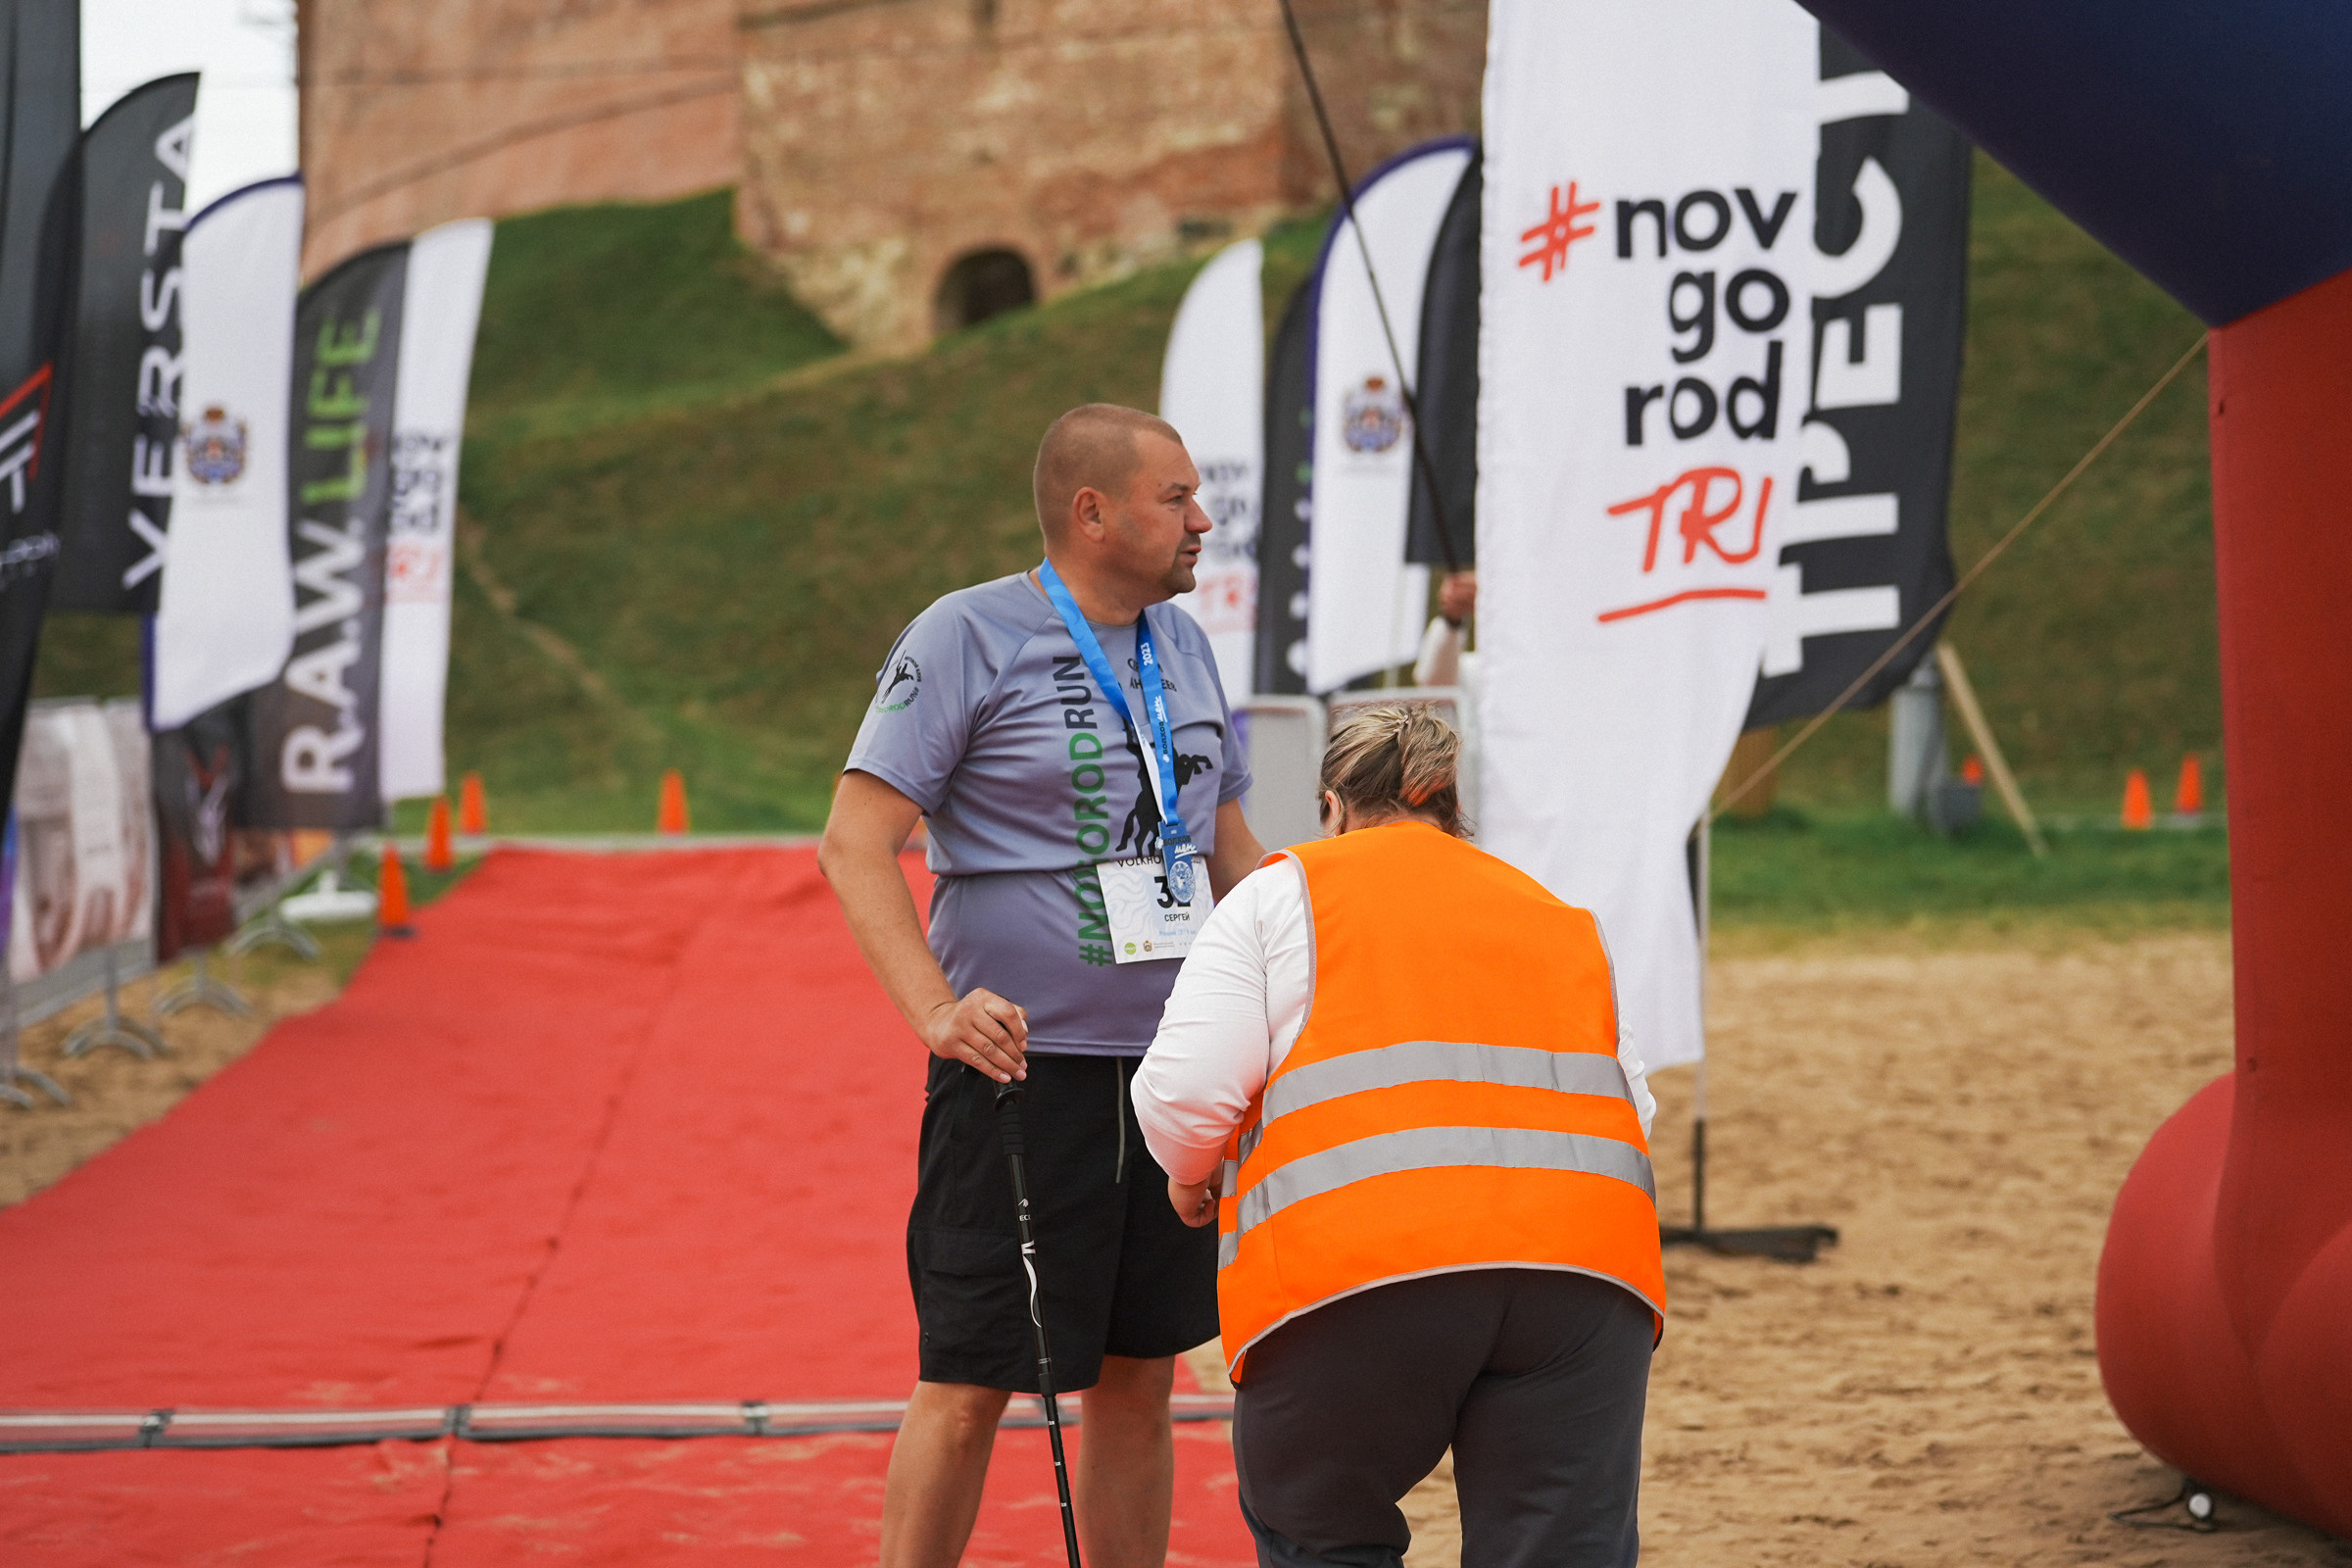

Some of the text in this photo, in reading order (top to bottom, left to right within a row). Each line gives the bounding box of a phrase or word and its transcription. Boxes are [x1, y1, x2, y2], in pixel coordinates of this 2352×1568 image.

[1669, 269, 1790, 364] go
[301, 310, 381, 505] LIFE
[1624, 340, 1784, 446] rod
[1607, 466, 1773, 573] TRI
[1141, 642, 1153, 666] 2023
[1053, 656, 1113, 967] #NOORODRUN
[1117, 855, 1162, 867] VOLKHO
[1153, 875, 1192, 908] 3
[1164, 912, 1191, 922] СЕРГЕЙ
